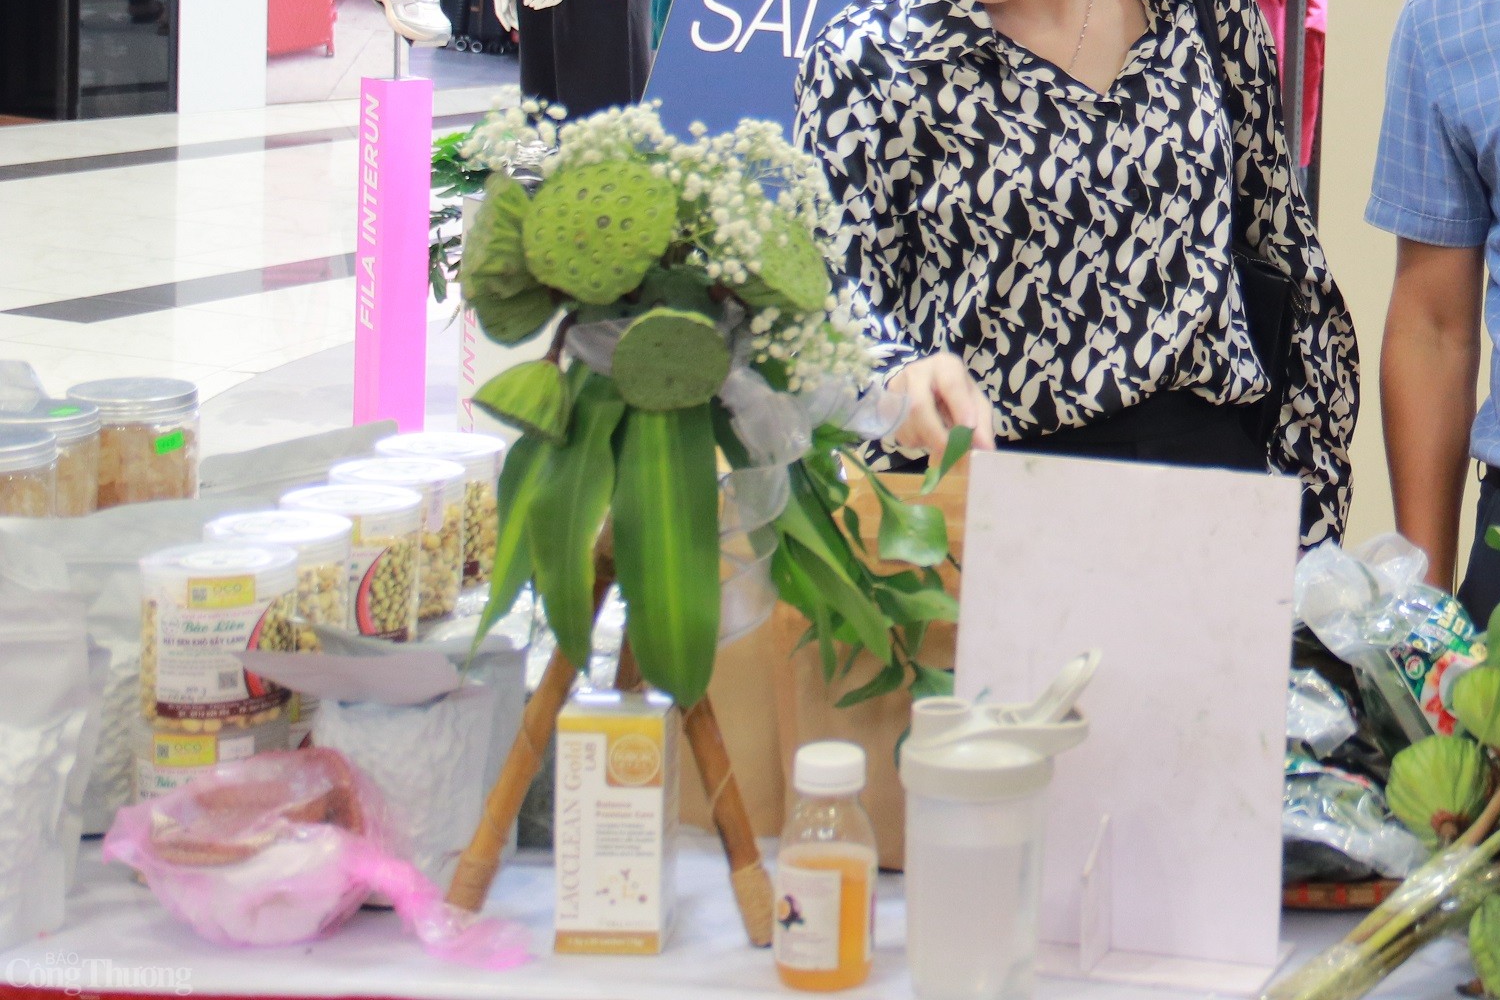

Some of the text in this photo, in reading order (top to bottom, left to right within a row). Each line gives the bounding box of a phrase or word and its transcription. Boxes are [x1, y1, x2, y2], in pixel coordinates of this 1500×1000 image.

[360, 93, 381, 330] FILA INTERUN
[560, 740, 583, 921] LACCLEAN Gold
